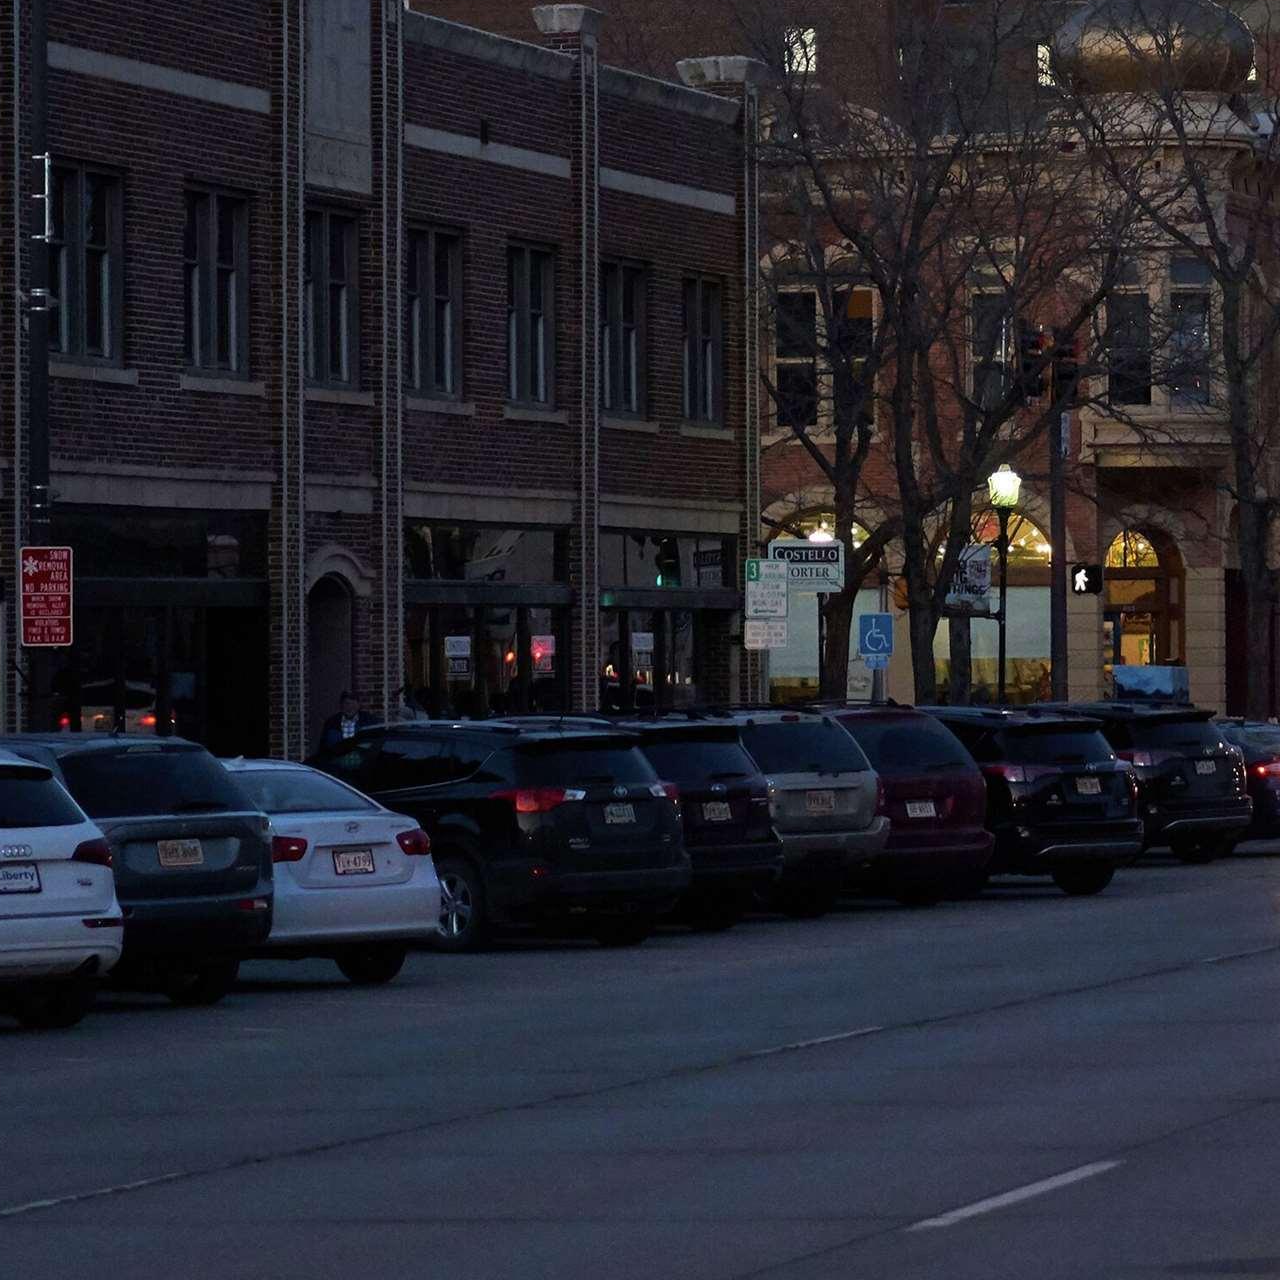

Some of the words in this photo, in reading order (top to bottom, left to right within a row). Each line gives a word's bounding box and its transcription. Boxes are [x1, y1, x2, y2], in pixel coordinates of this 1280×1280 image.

[49, 550, 68, 560] SNOW
[774, 548, 838, 561] COSTELLO
[39, 561, 67, 571] REMOVAL
[750, 562, 757, 578] 3
[50, 571, 68, 581] AREA
[788, 566, 830, 578] ORTER
[25, 583, 35, 593] NO
[40, 583, 68, 593] PARKING
